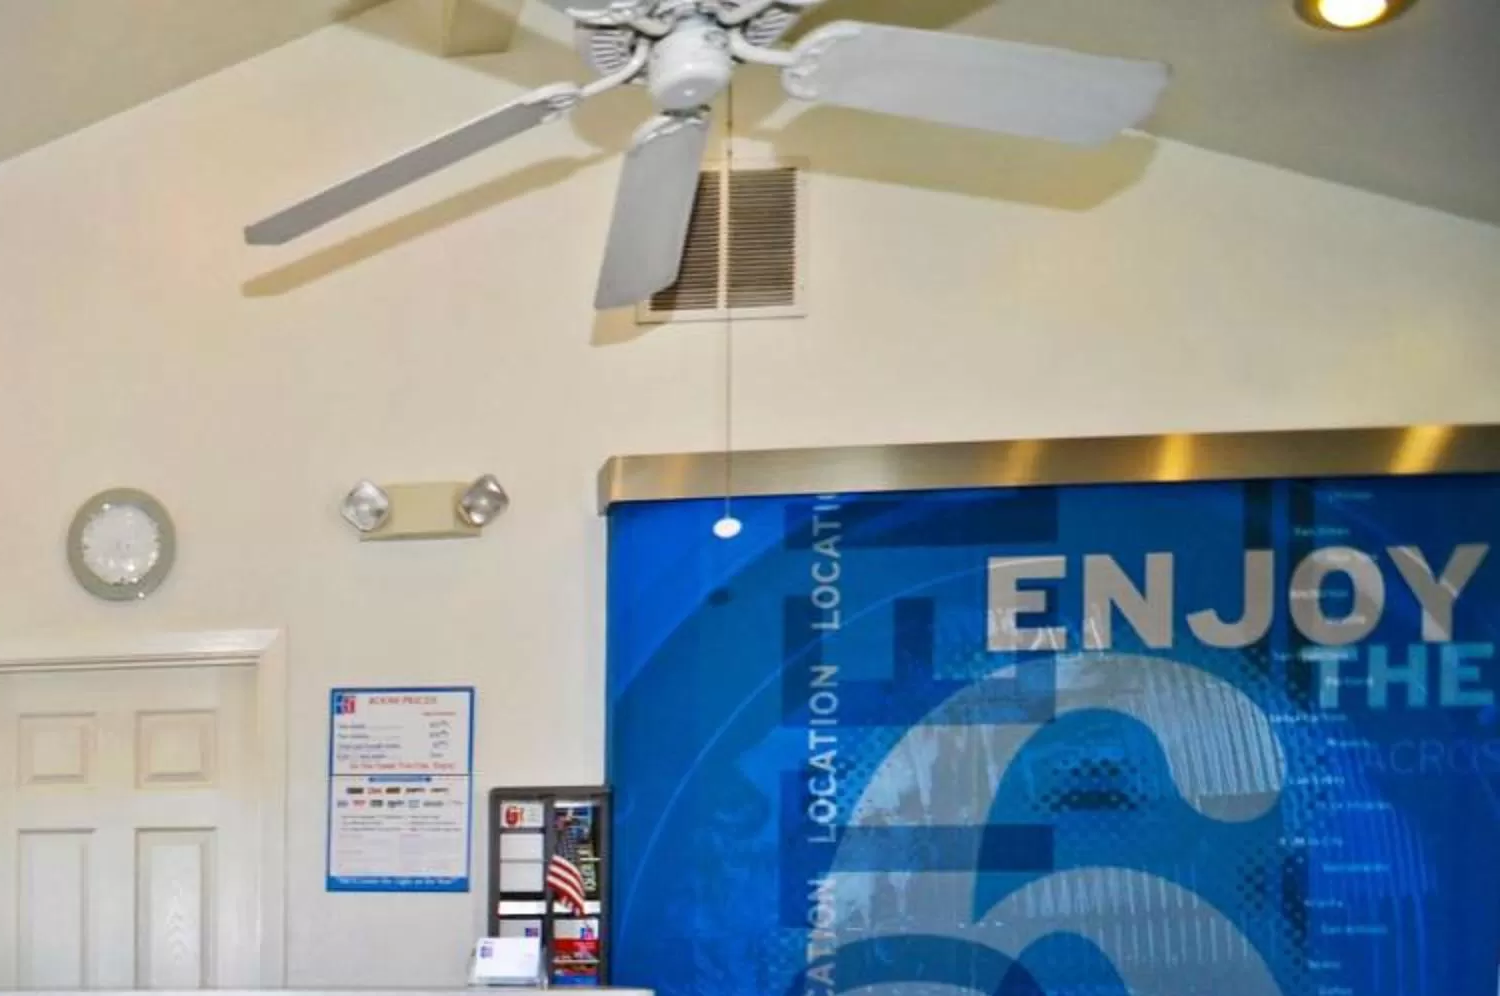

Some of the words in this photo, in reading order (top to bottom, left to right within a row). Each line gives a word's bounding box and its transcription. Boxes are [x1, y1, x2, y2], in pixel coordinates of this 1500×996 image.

[986, 543, 1490, 652] ENJOY
[1304, 642, 1495, 710] THE
[807, 665, 839, 843] LOCATION
